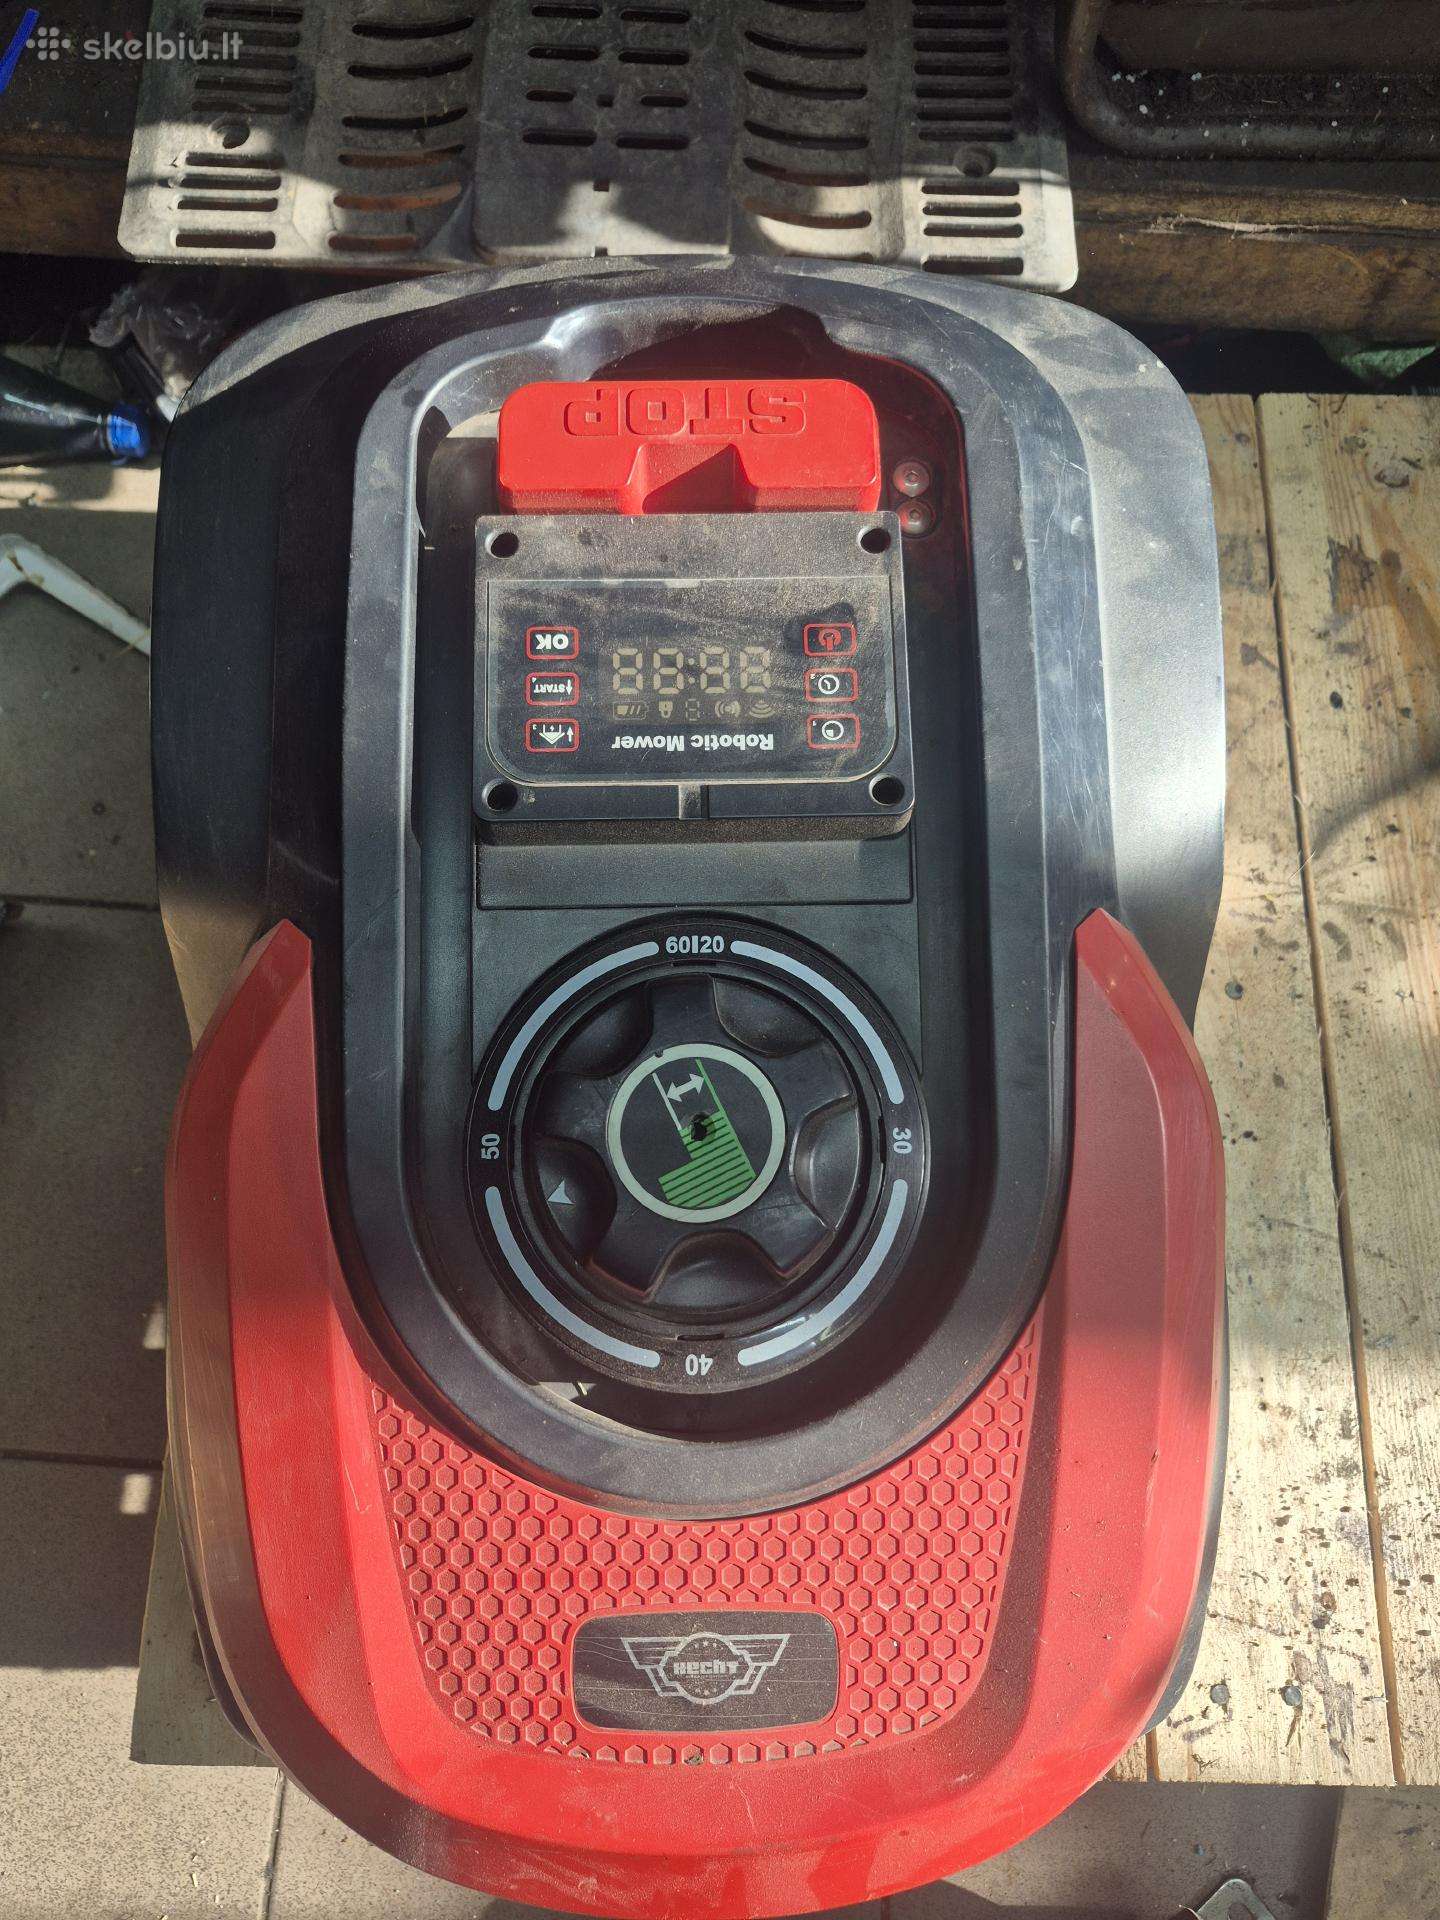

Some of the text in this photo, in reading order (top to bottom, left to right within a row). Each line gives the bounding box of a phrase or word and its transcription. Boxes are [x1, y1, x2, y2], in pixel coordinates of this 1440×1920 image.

[563, 386, 807, 437] STOP
[535, 633, 569, 651] OK
[533, 683, 566, 694] START
[611, 733, 774, 752] Robotic Mower
[481, 1133, 499, 1160] 50
[892, 1127, 912, 1154] 30
[685, 1354, 713, 1376] 40
